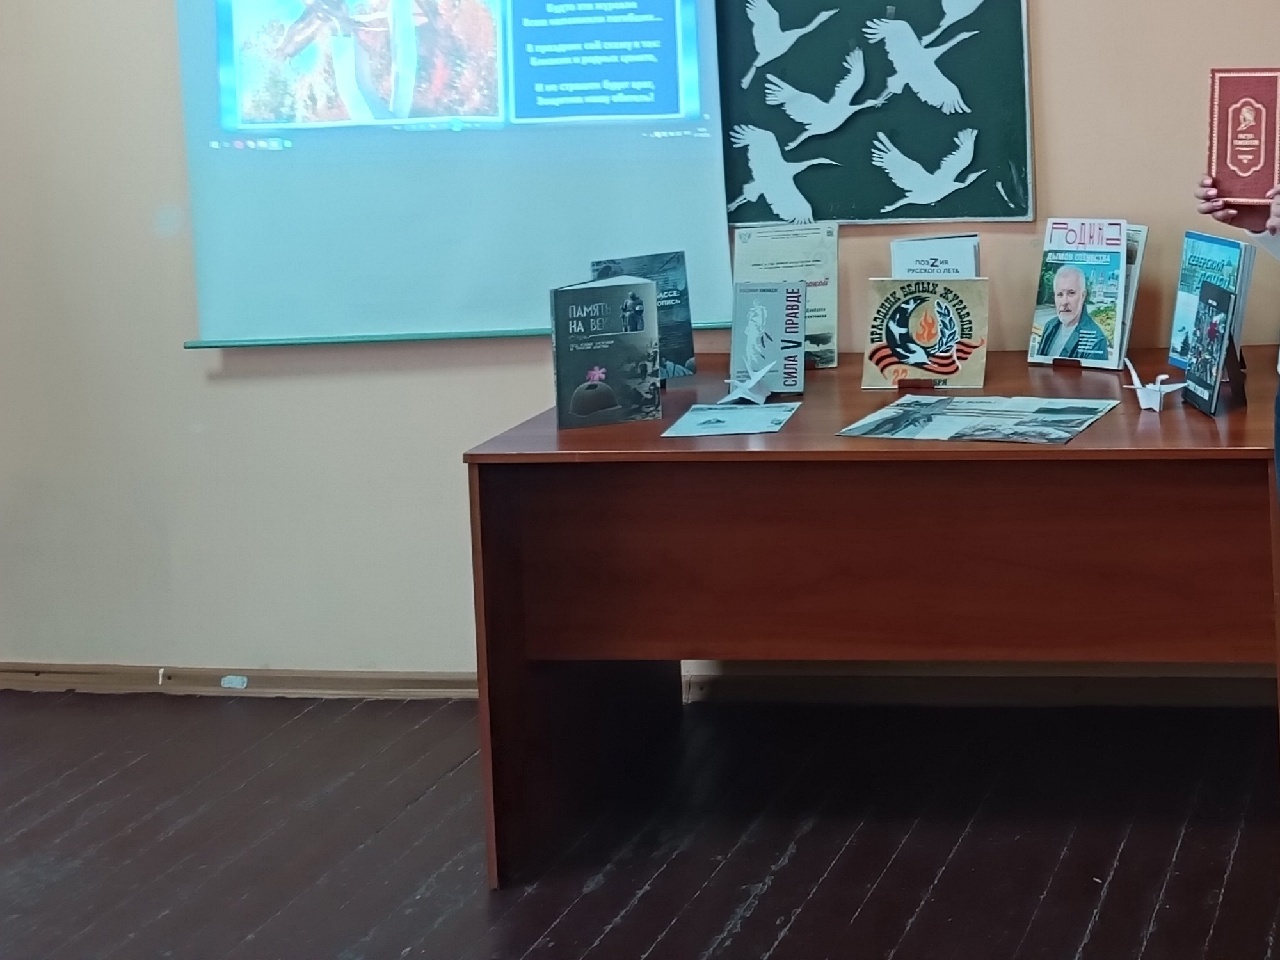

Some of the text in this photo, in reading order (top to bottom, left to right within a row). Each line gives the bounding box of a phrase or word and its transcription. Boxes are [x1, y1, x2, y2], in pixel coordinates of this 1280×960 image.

[900, 281, 938, 298] БЕЛЫХ
[569, 303, 612, 318] ПАМЯТЬ
[570, 320, 584, 334] НА
[780, 288, 802, 387] СИЛА V ПРАВДЕ
